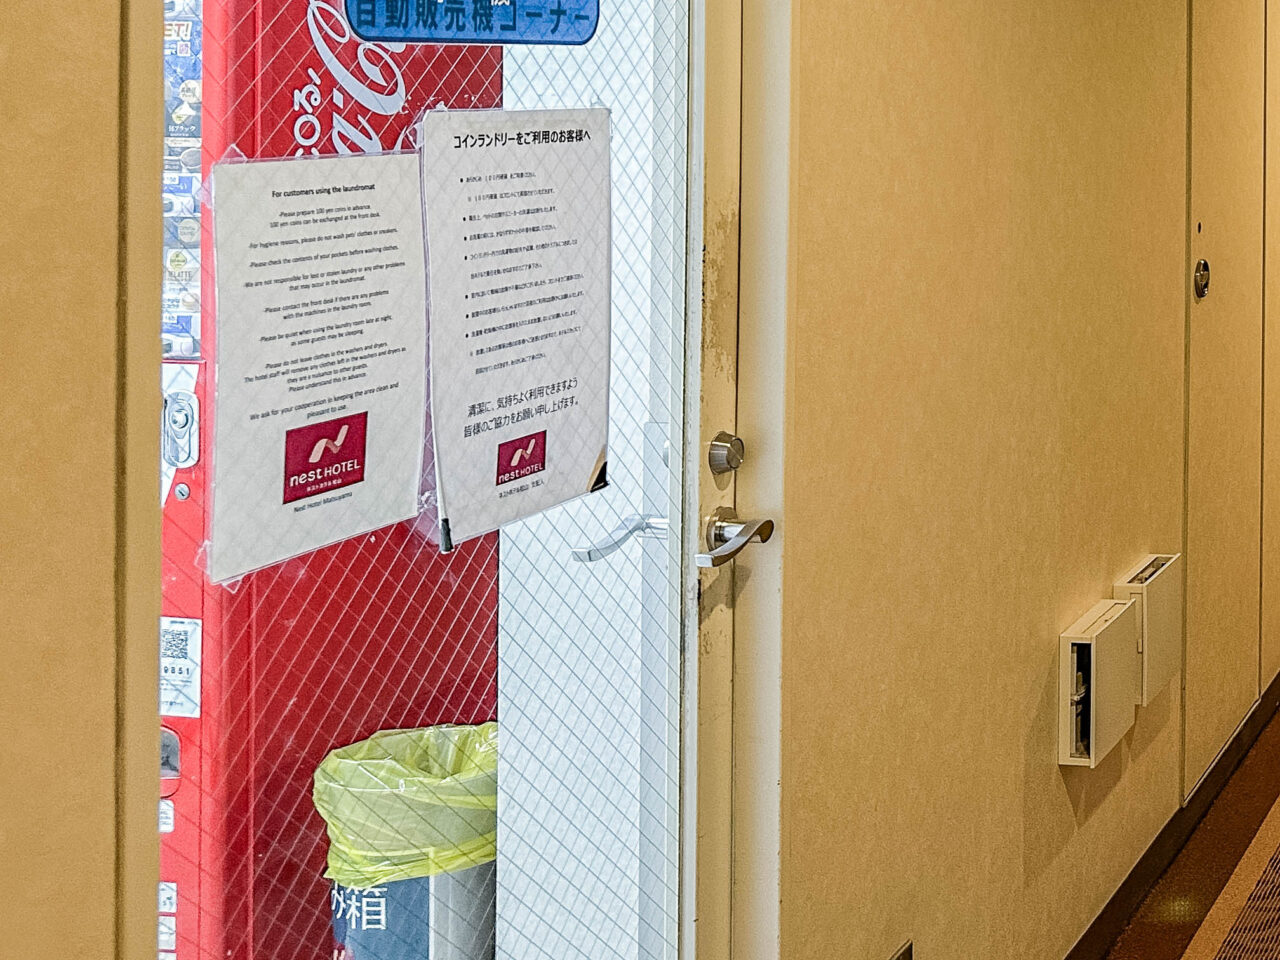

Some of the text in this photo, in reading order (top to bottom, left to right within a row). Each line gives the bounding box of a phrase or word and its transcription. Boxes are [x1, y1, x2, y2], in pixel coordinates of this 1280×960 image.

[453, 129, 592, 149] コインランドリーをご利用のお客様へ
[289, 457, 360, 487] nest HOTEL
[498, 463, 544, 483] nest HOTEL
